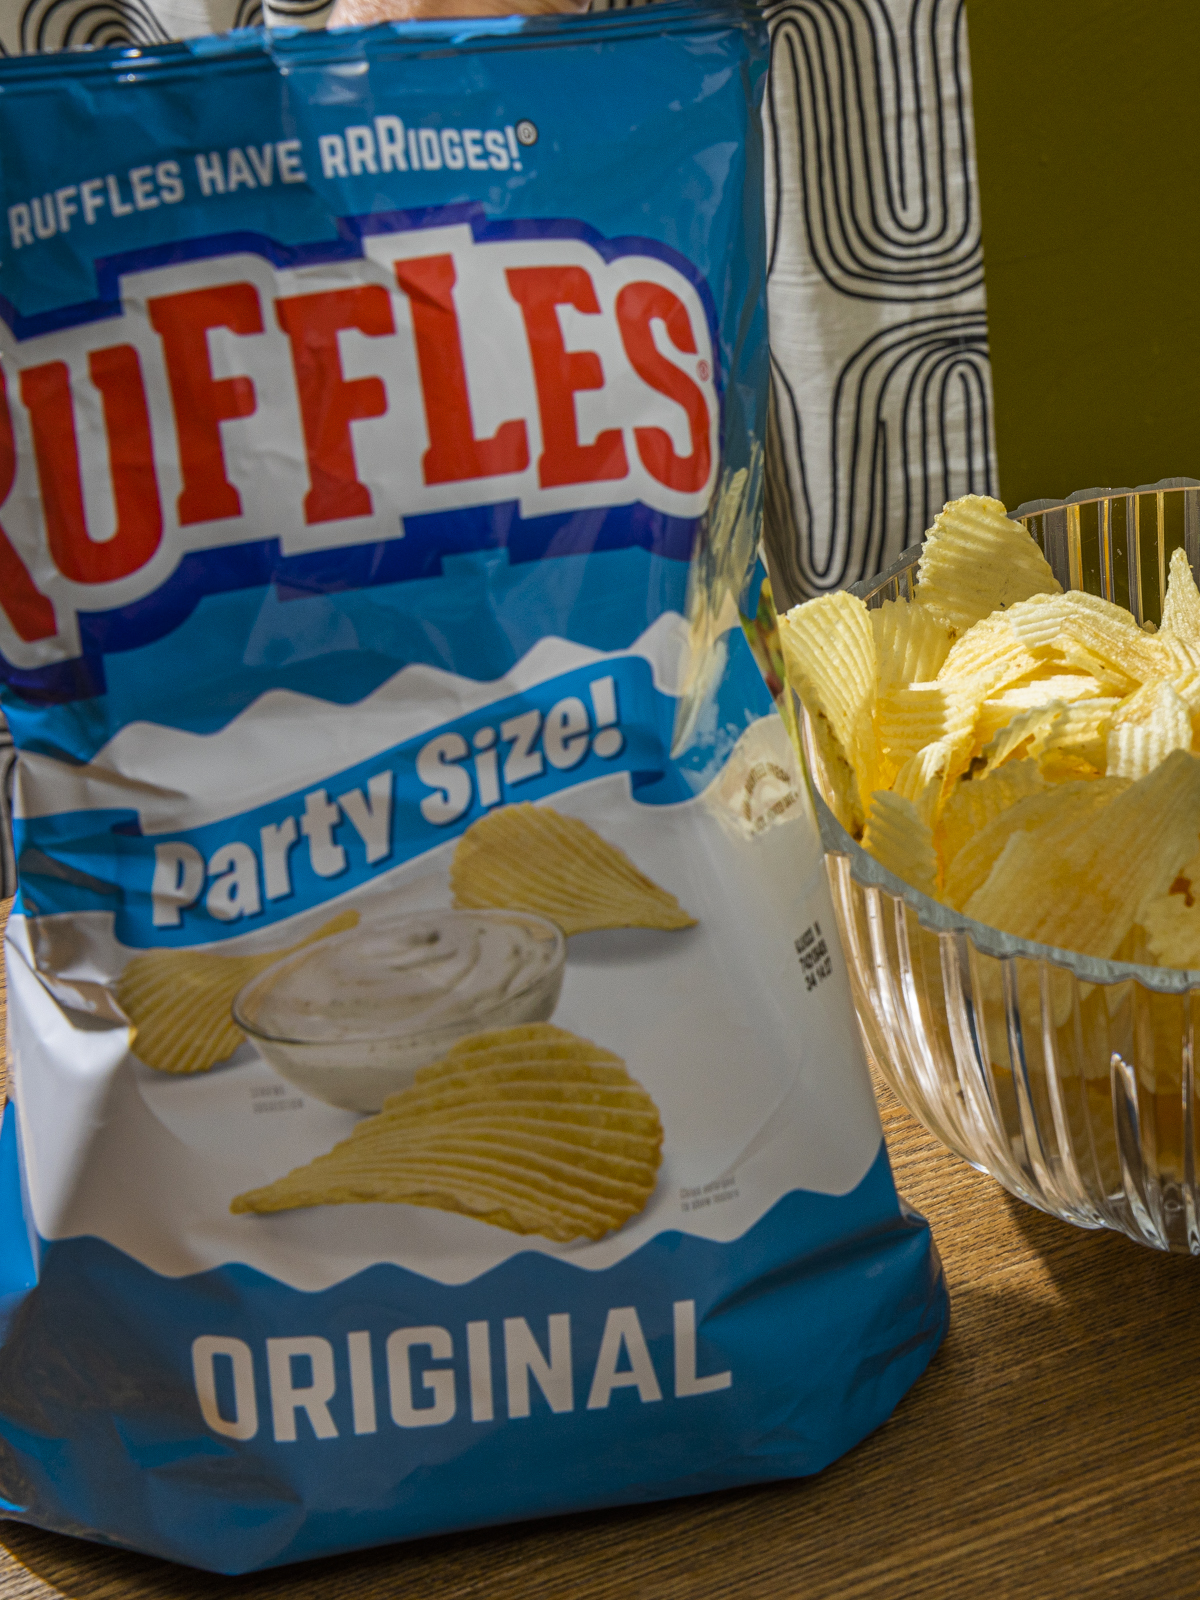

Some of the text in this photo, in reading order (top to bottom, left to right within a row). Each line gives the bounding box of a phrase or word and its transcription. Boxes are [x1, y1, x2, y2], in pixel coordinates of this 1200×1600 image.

[8, 160, 186, 249] RUFFLES
[194, 138, 307, 197] HAVE
[152, 769, 394, 927] Party
[415, 674, 624, 826] Size!
[191, 1299, 732, 1443] ORIGINAL
